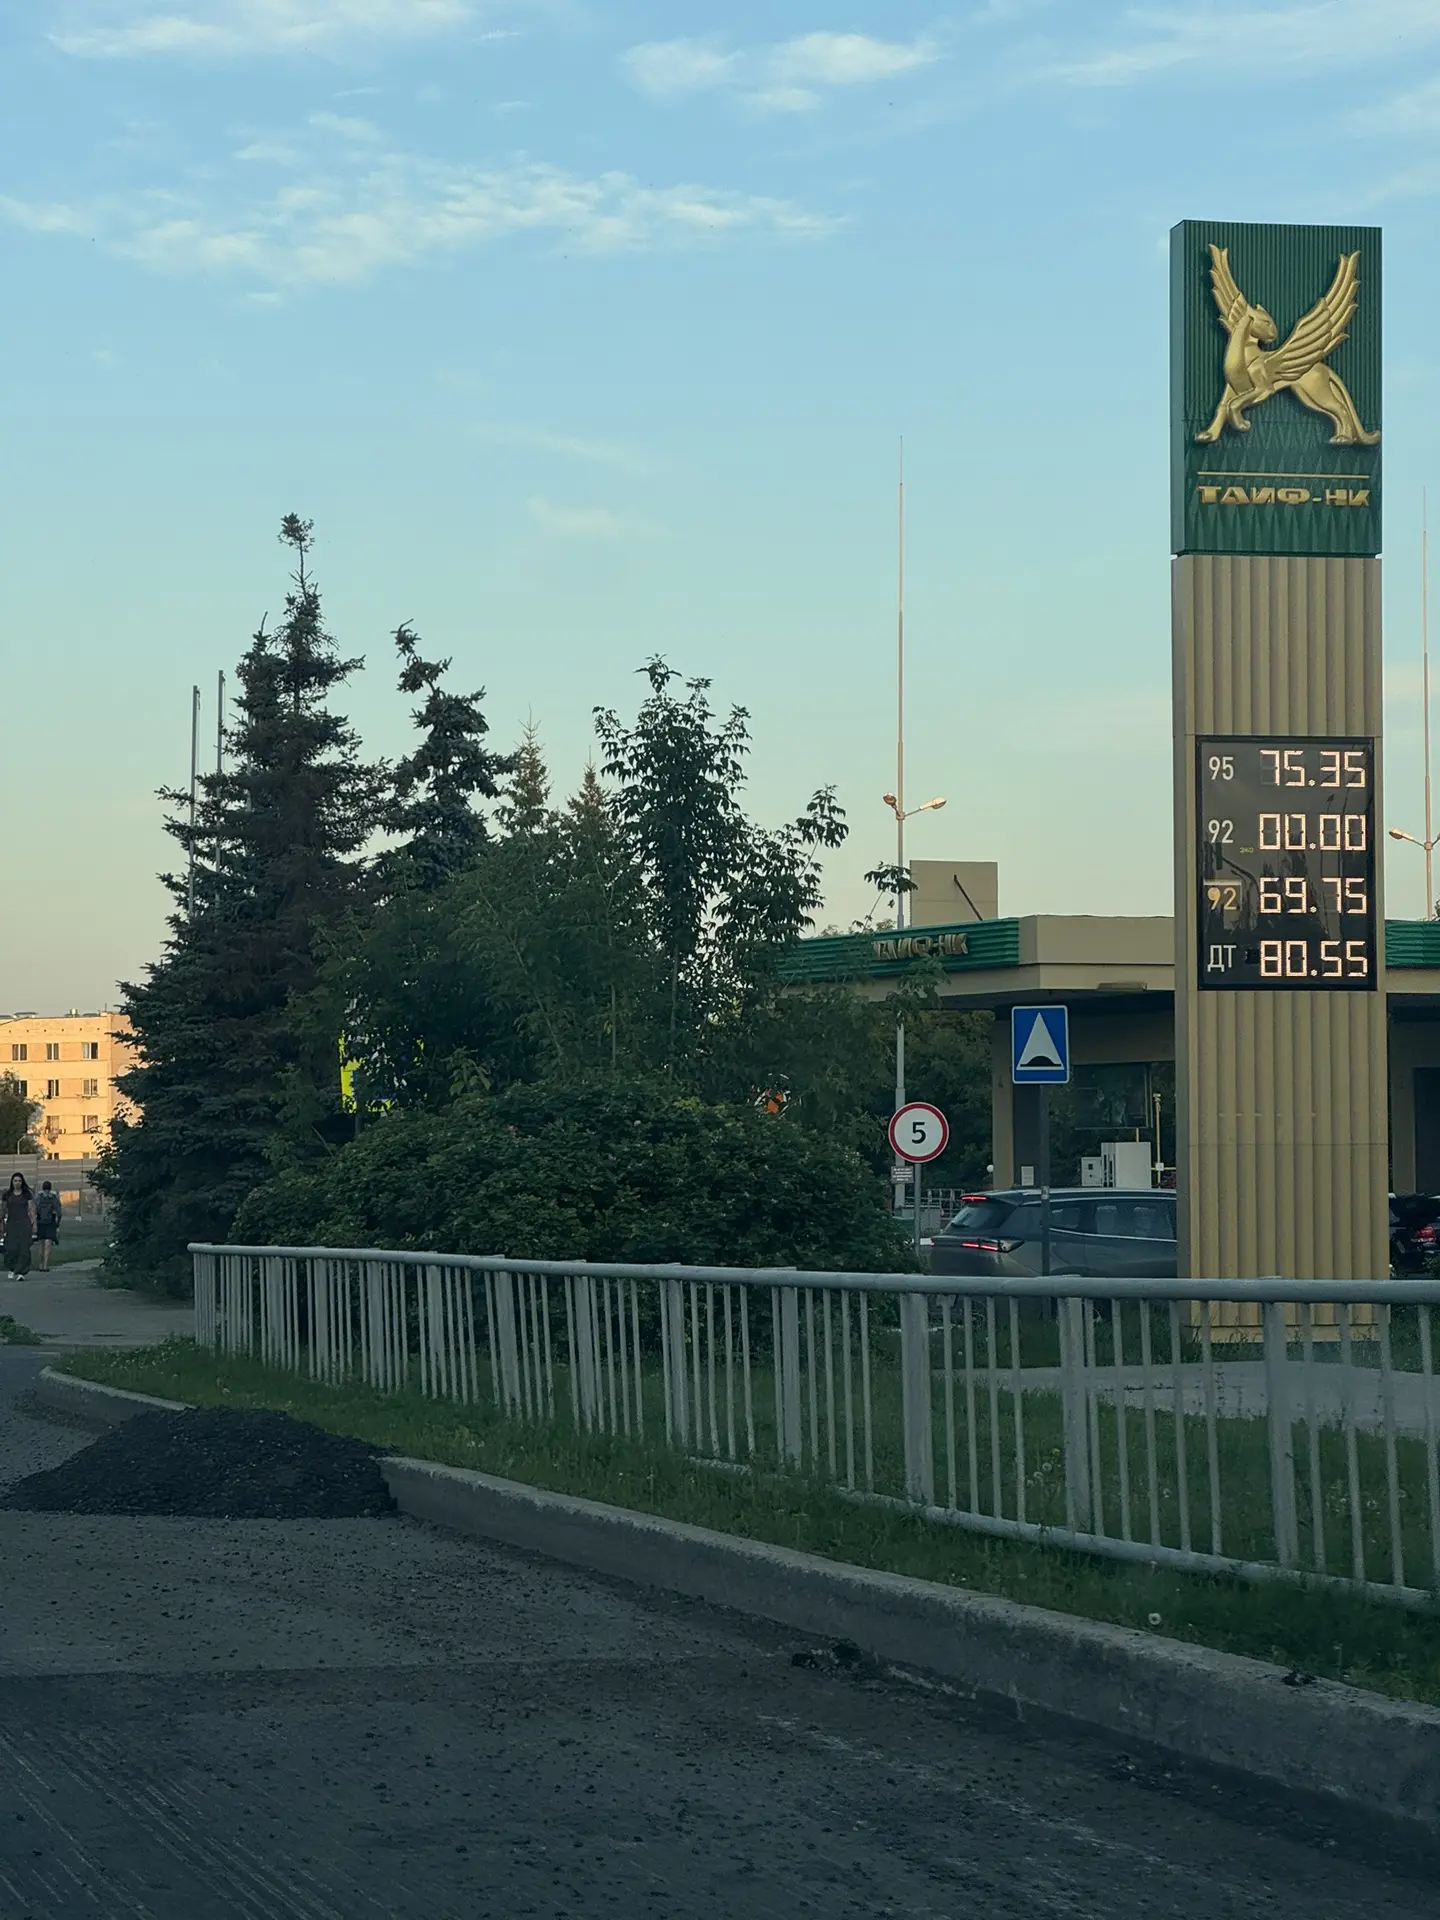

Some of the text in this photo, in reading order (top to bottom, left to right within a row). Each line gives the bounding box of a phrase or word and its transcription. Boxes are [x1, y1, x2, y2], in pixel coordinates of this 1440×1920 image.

[1208, 750, 1366, 788] 95 75.35
[1208, 814, 1366, 850] 92 00.00
[1207, 877, 1367, 914] 92 69.75
[1207, 940, 1368, 977] ДТ 80.55
[911, 1122, 926, 1144] 5
